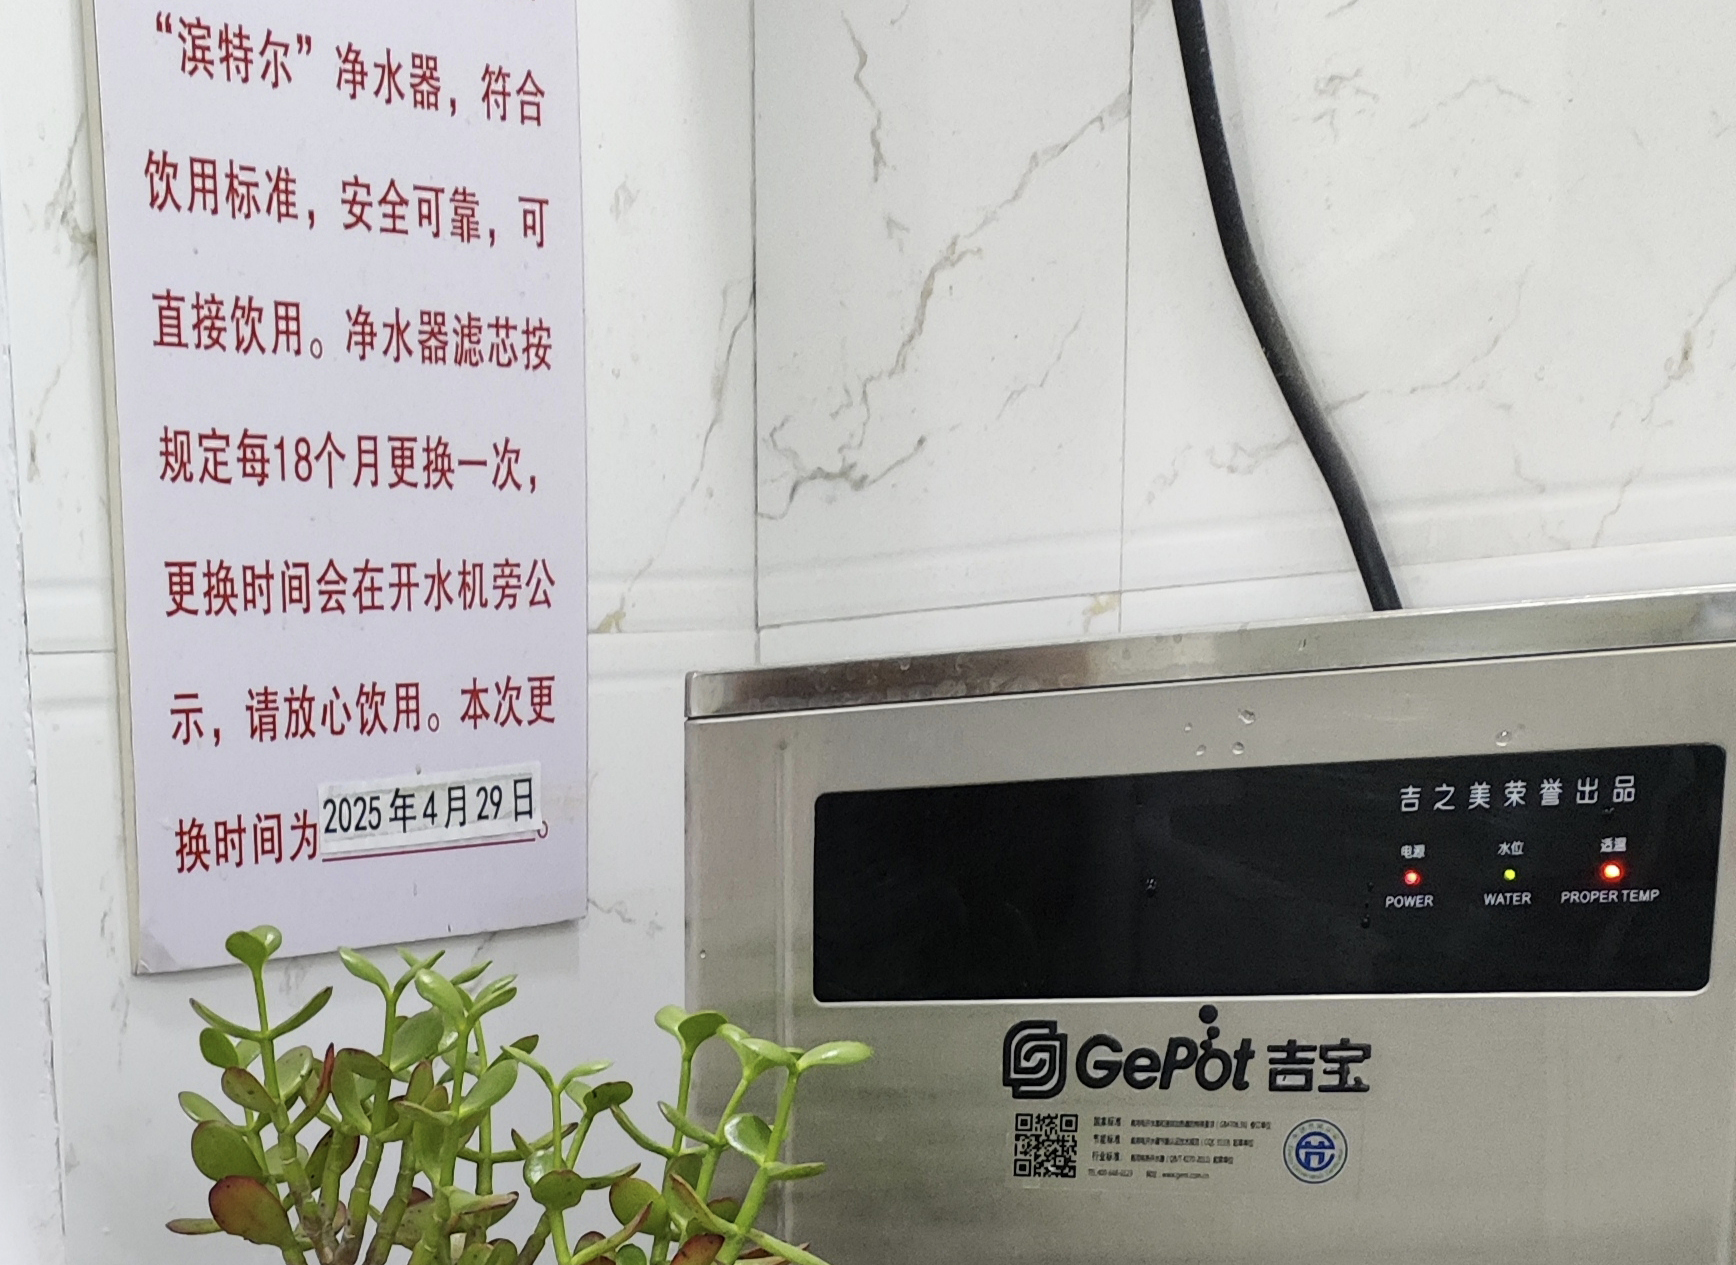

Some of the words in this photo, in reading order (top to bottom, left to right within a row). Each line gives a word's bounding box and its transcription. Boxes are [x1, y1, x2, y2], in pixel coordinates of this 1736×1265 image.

[153, 289, 552, 370] 直接饮用。净水器滤芯按
[159, 426, 537, 493] 规定每18个月更换一次，
[165, 558, 556, 617] 更换时间会在开水机旁公
[170, 675, 555, 746] 示，请放心饮用。本次更
[1399, 775, 1635, 812] 吉之美荣誉出品
[1498, 841, 1524, 855] 水位
[1385, 895, 1434, 907] POWER
[1484, 892, 1532, 905] WATER
[1561, 890, 1618, 903] PROPER
[1621, 889, 1660, 901] TEMP
[1075, 1030, 1255, 1091] GePot
[1267, 1038, 1371, 1093] 吉宝
